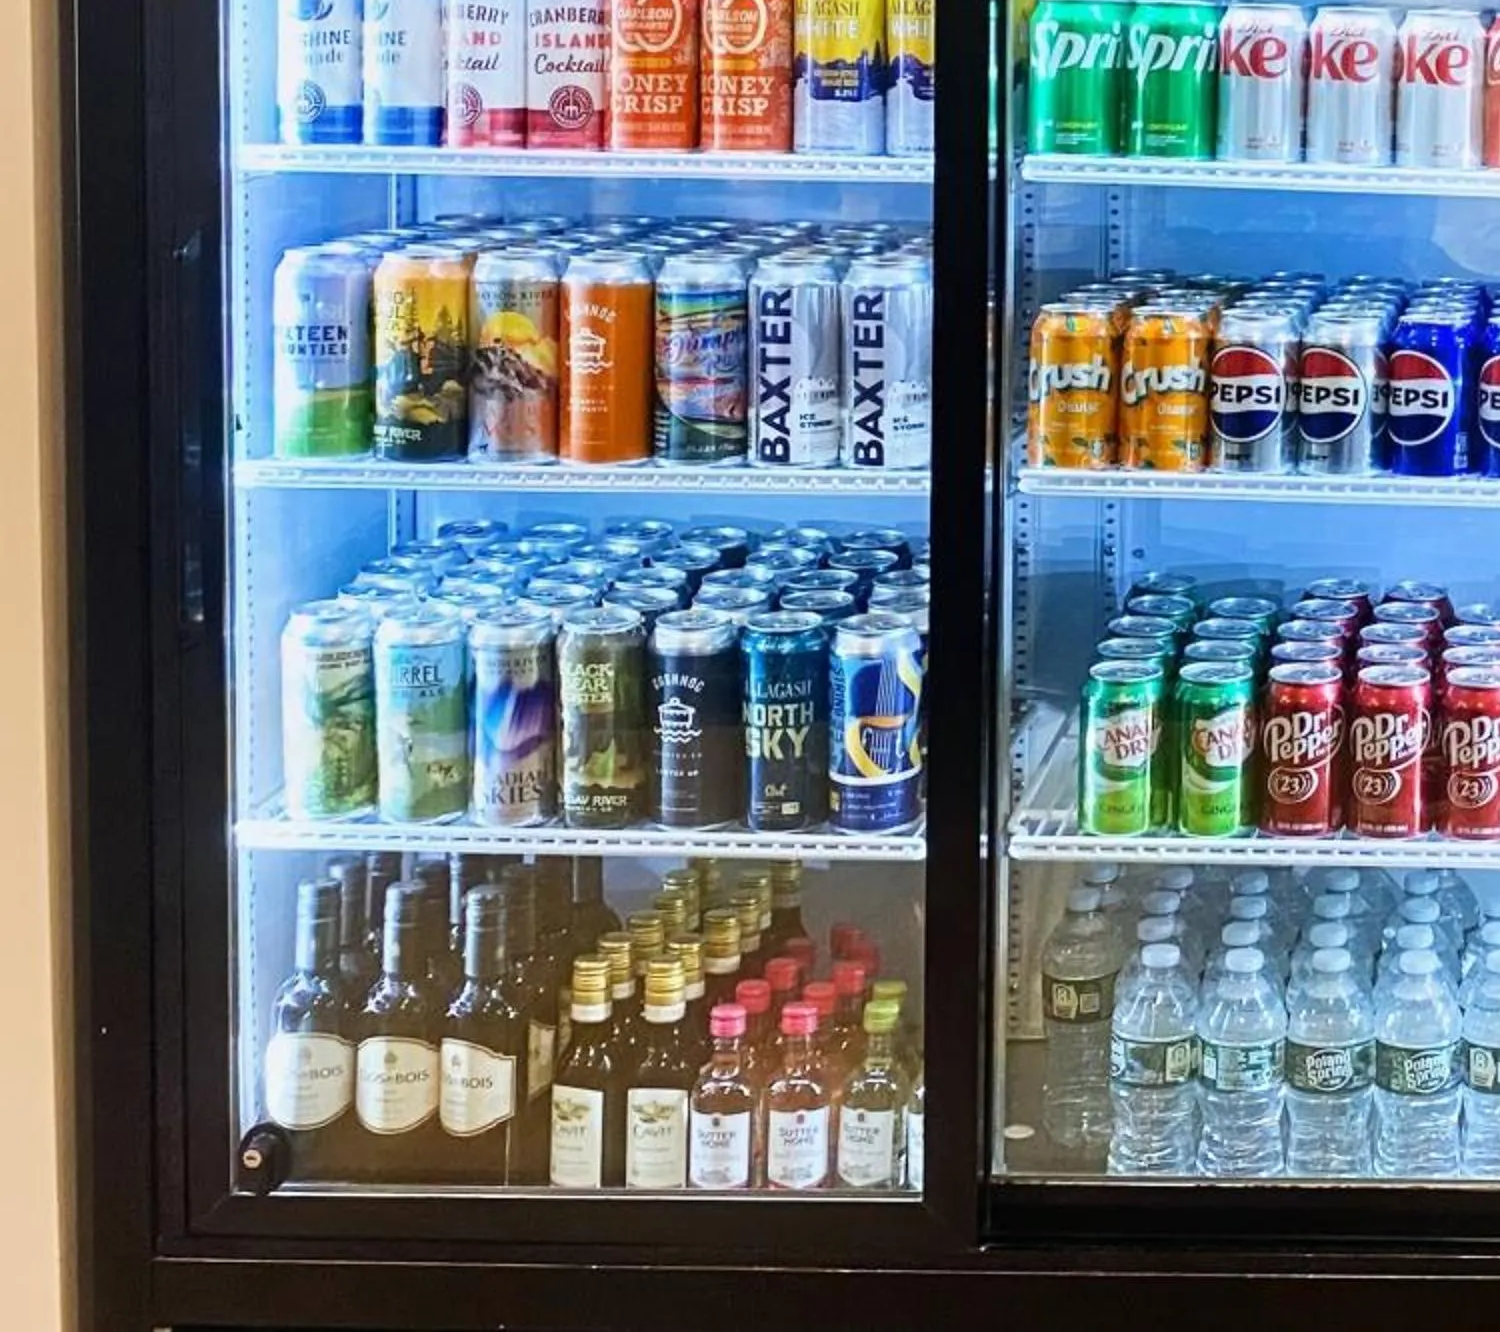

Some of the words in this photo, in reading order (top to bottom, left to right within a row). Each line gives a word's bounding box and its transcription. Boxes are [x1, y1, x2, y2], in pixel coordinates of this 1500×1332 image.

[529, 6, 606, 28] CRANBERR
[533, 53, 610, 75] Cocktail
[611, 95, 684, 114] CRISP
[701, 96, 770, 117] CRISP
[760, 288, 792, 463] BAXTER
[853, 290, 885, 467] BAXTER
[1028, 354, 1111, 403] Crush
[1119, 354, 1206, 407] Crush
[1212, 383, 1282, 404] PEPSI
[743, 701, 815, 728] NORTH
[1293, 712, 1327, 734] Dr
[1379, 713, 1410, 734] Dr
[745, 726, 810, 760] SKY
[1271, 719, 1342, 764] Pepper
[1355, 719, 1427, 763] Pepper
[1280, 776, 1301, 793] 23
[1362, 776, 1382, 794] 23
[1460, 782, 1480, 799] 23
[1305, 1050, 1350, 1070] Poland
[1307, 1066, 1351, 1087] Spring
